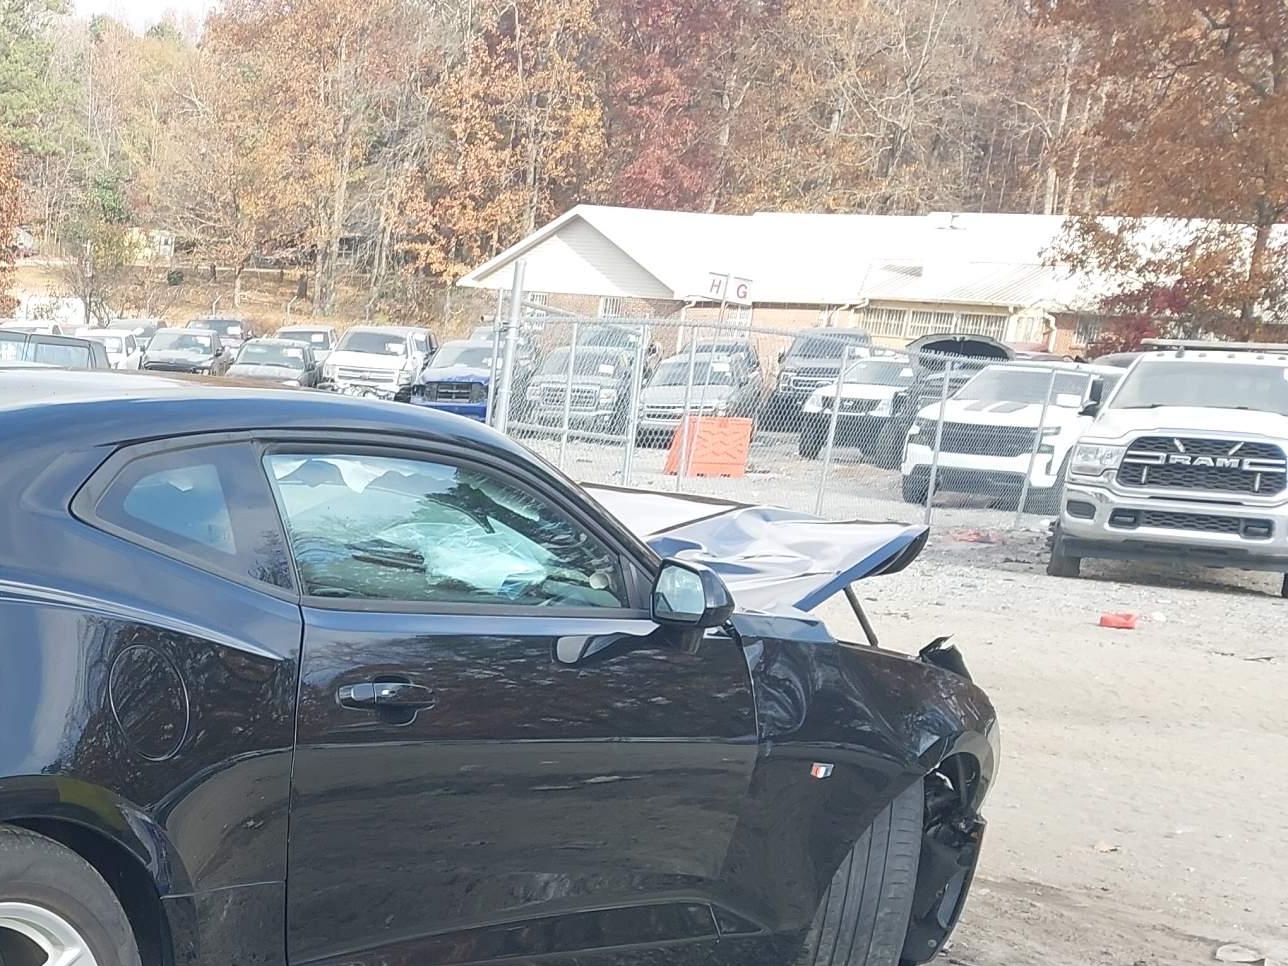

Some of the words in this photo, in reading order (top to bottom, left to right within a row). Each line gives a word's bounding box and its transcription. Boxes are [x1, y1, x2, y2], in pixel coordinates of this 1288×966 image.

[709, 279, 722, 294] H
[736, 284, 748, 299] G
[1169, 455, 1240, 468] RAM
